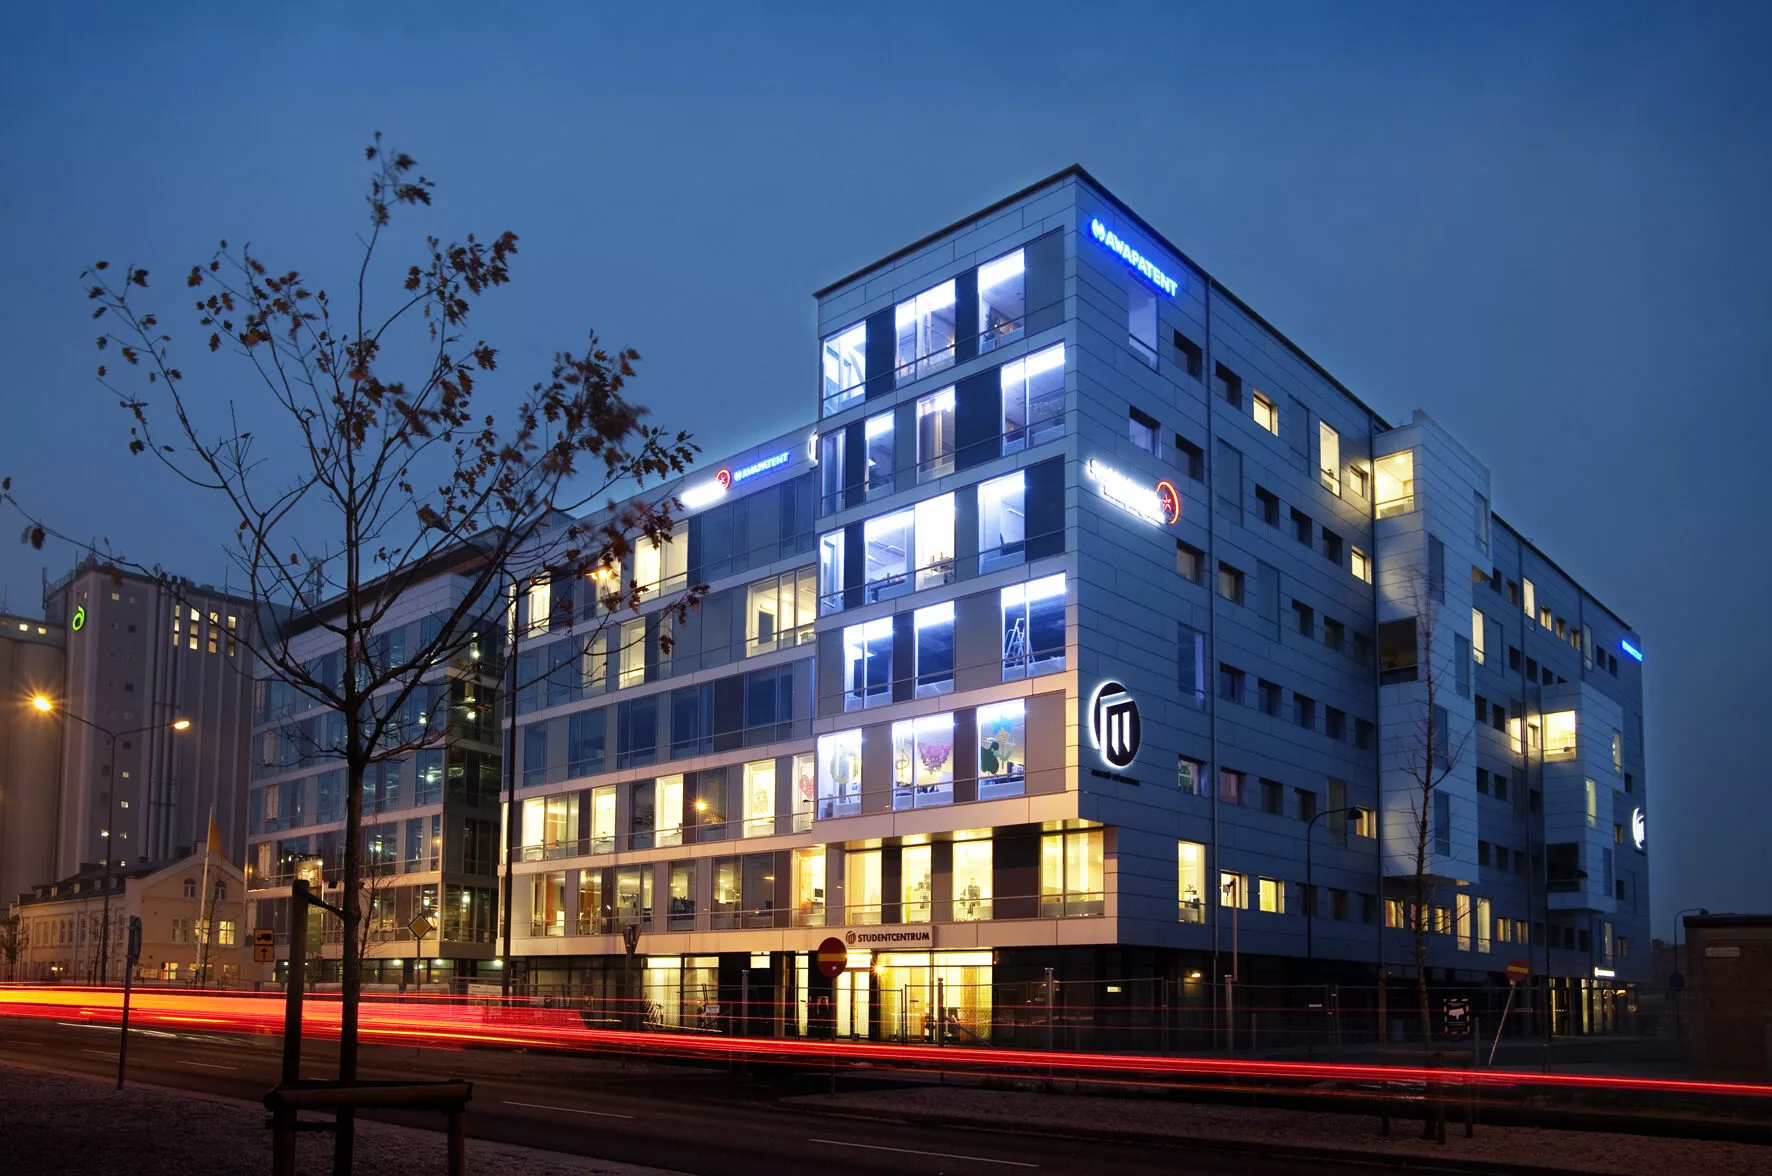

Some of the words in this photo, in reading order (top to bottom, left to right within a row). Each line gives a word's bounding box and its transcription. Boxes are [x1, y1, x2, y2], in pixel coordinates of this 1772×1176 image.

[1105, 231, 1178, 297] AWAPATENT
[742, 452, 789, 478] AWAPATENT
[858, 932, 930, 943] STUDENTCENTRUM
